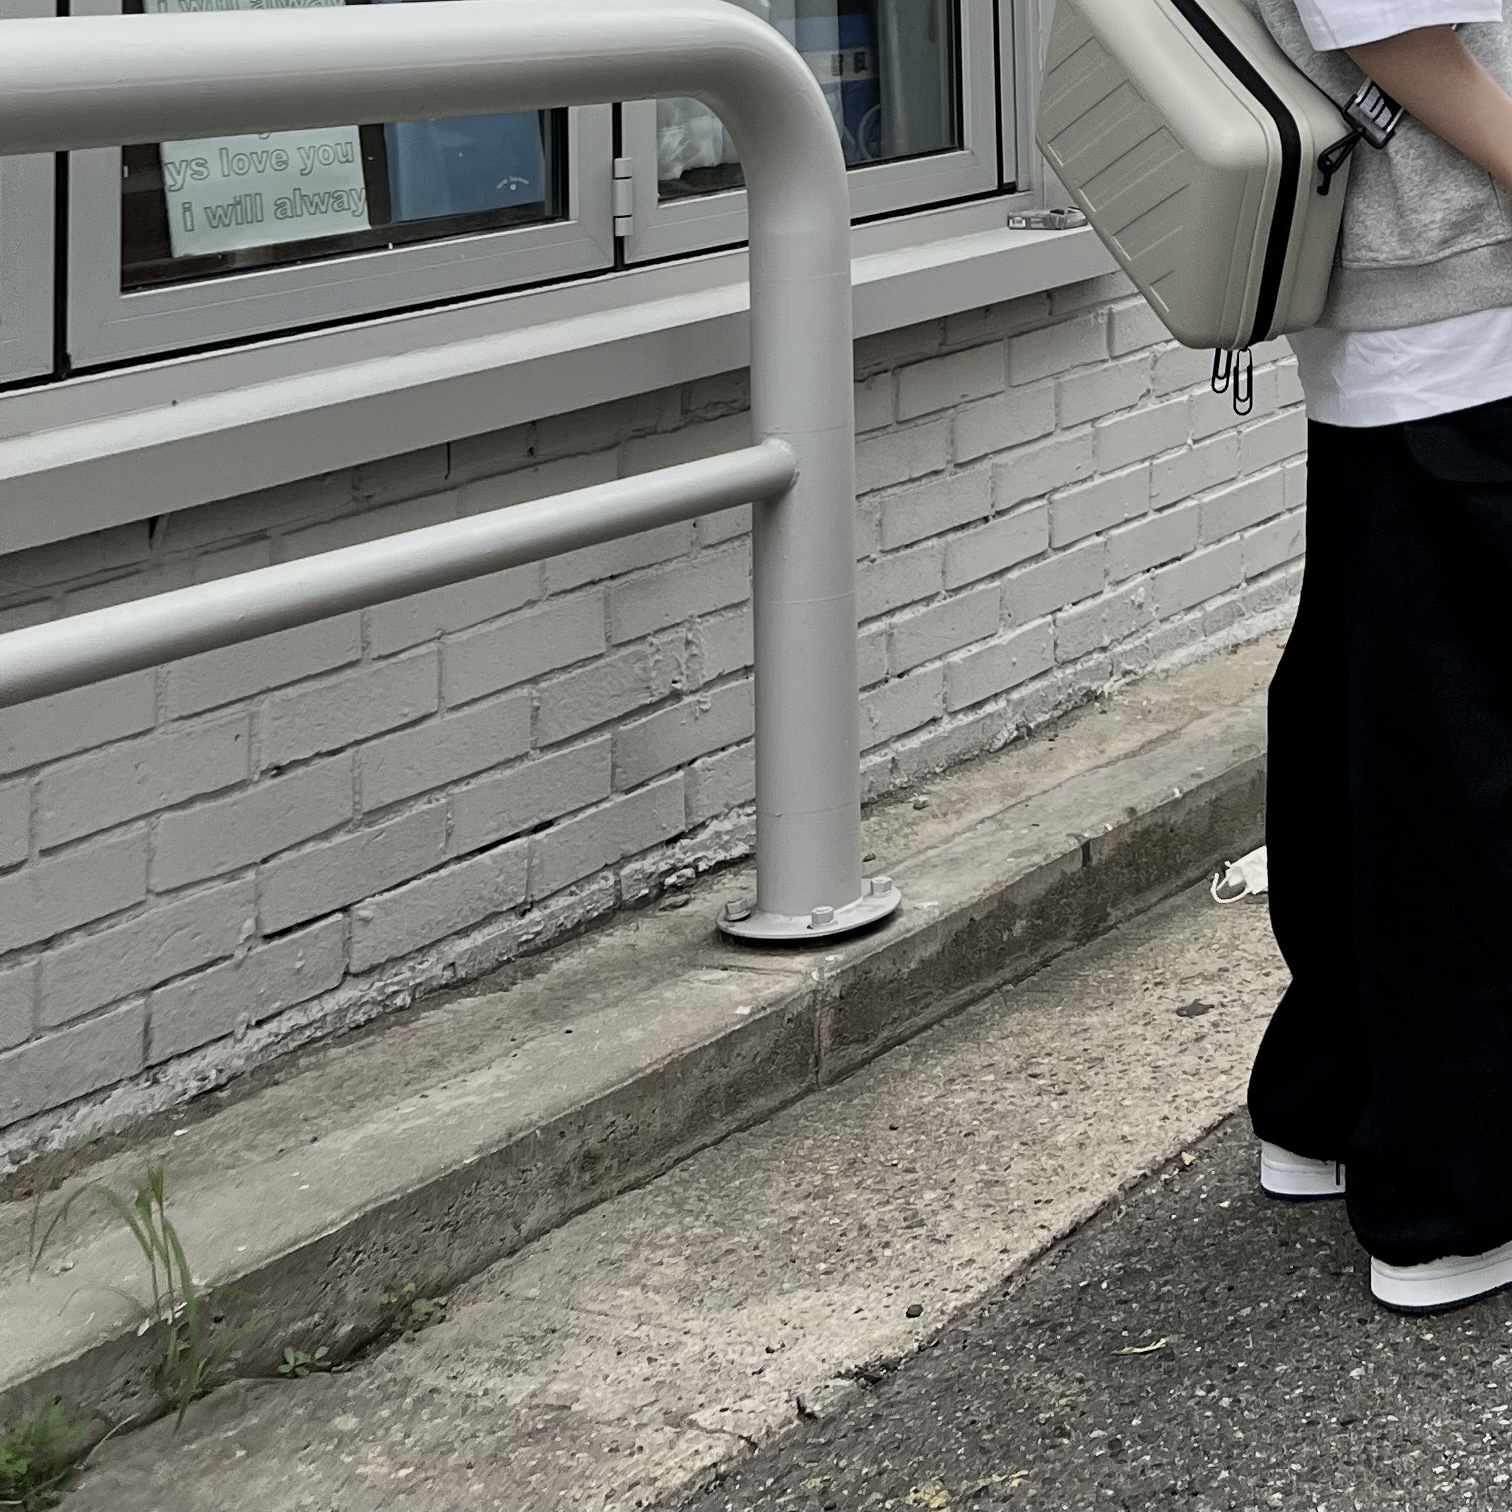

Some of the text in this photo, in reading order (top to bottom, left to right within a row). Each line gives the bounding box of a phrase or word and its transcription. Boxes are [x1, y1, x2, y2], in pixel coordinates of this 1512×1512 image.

[218, 147, 290, 177] love
[297, 141, 354, 176] you
[181, 187, 366, 232] i will alway
